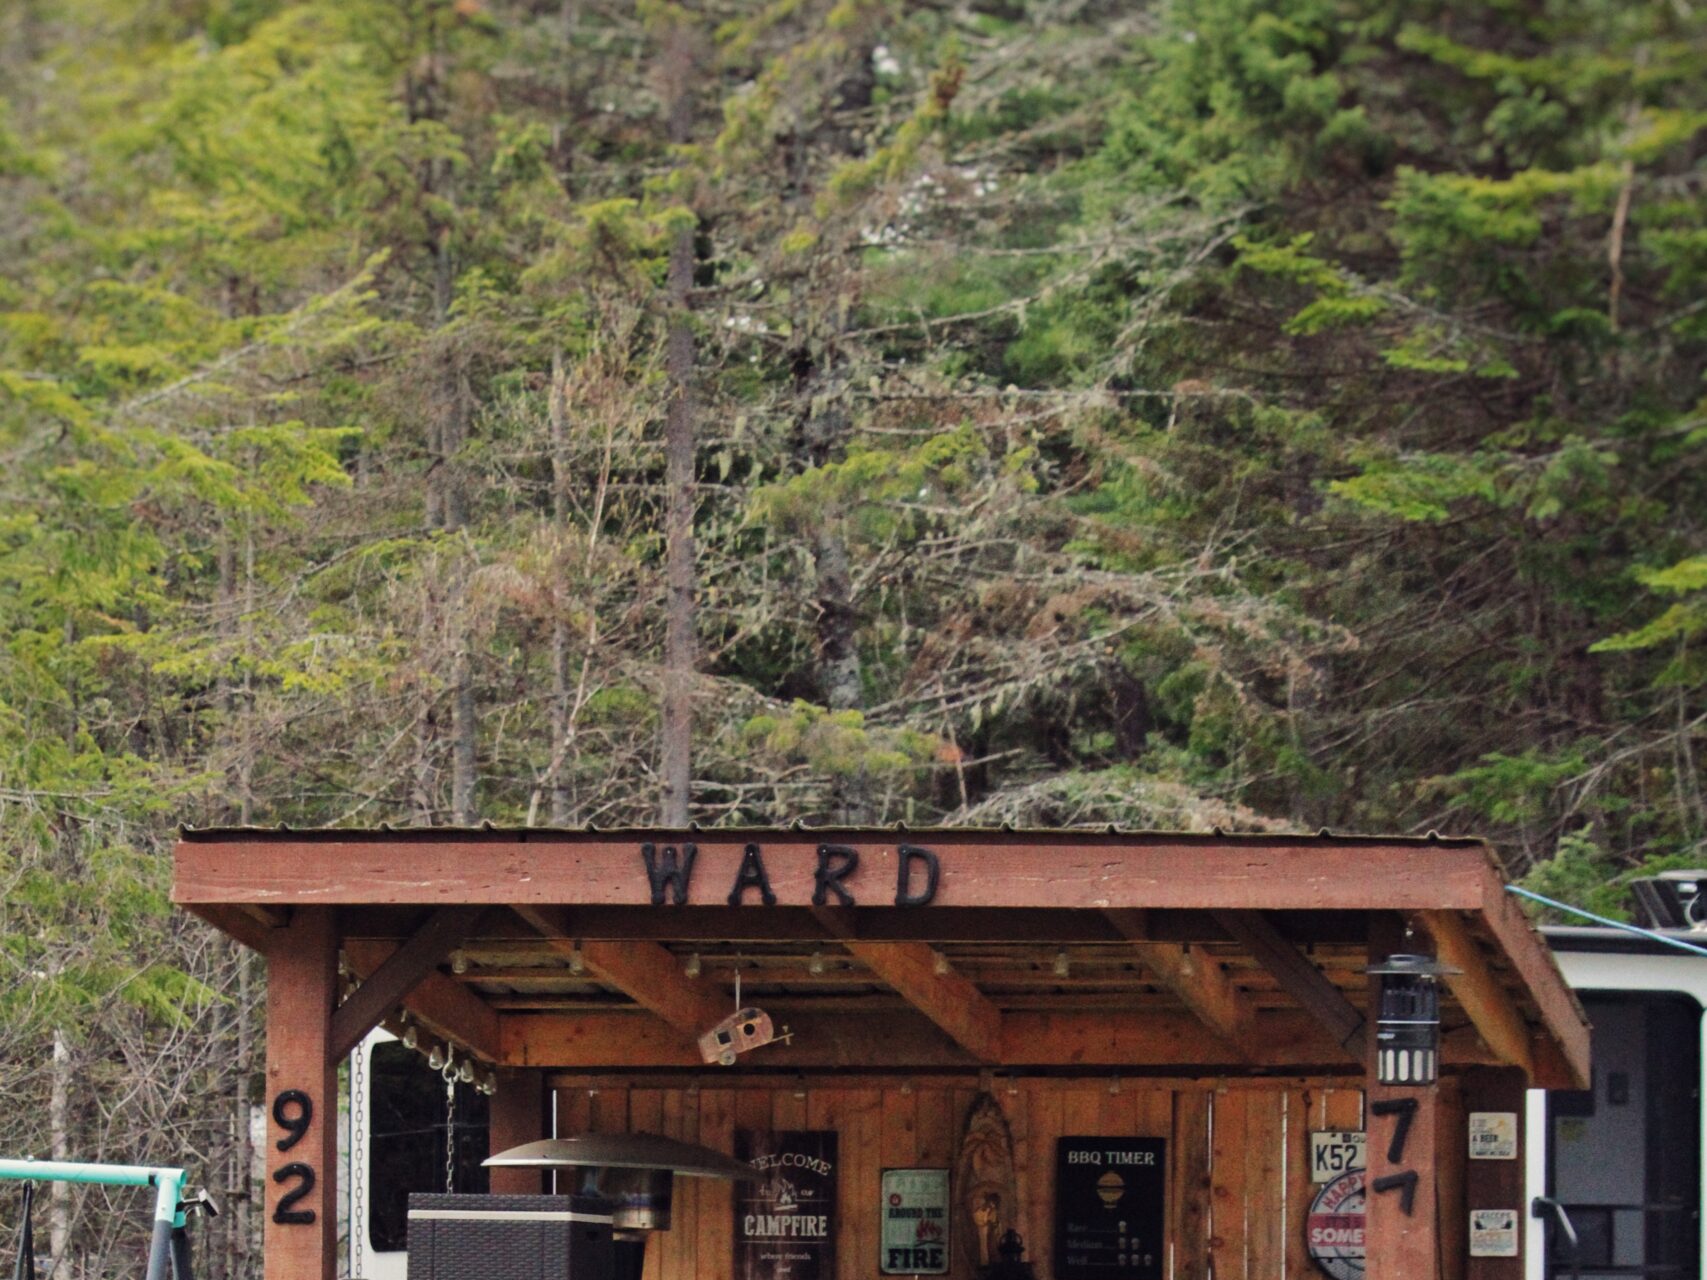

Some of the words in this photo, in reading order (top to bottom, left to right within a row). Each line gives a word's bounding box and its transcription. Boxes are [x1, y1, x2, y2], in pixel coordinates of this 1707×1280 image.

[641, 842, 939, 906] WARD
[1068, 1151, 1102, 1165] BBQ
[1105, 1151, 1155, 1165] TIMER
[1316, 1144, 1357, 1171] K52
[1322, 1173, 1366, 1209] HAPPY
[888, 1207, 923, 1218] AROUND
[925, 1207, 943, 1218] THE
[744, 1215, 827, 1237] CAMPFIRE
[1311, 1228, 1363, 1243] SOME
[1067, 1239, 1103, 1249] Medium
[888, 1248, 943, 1268] FIRE
